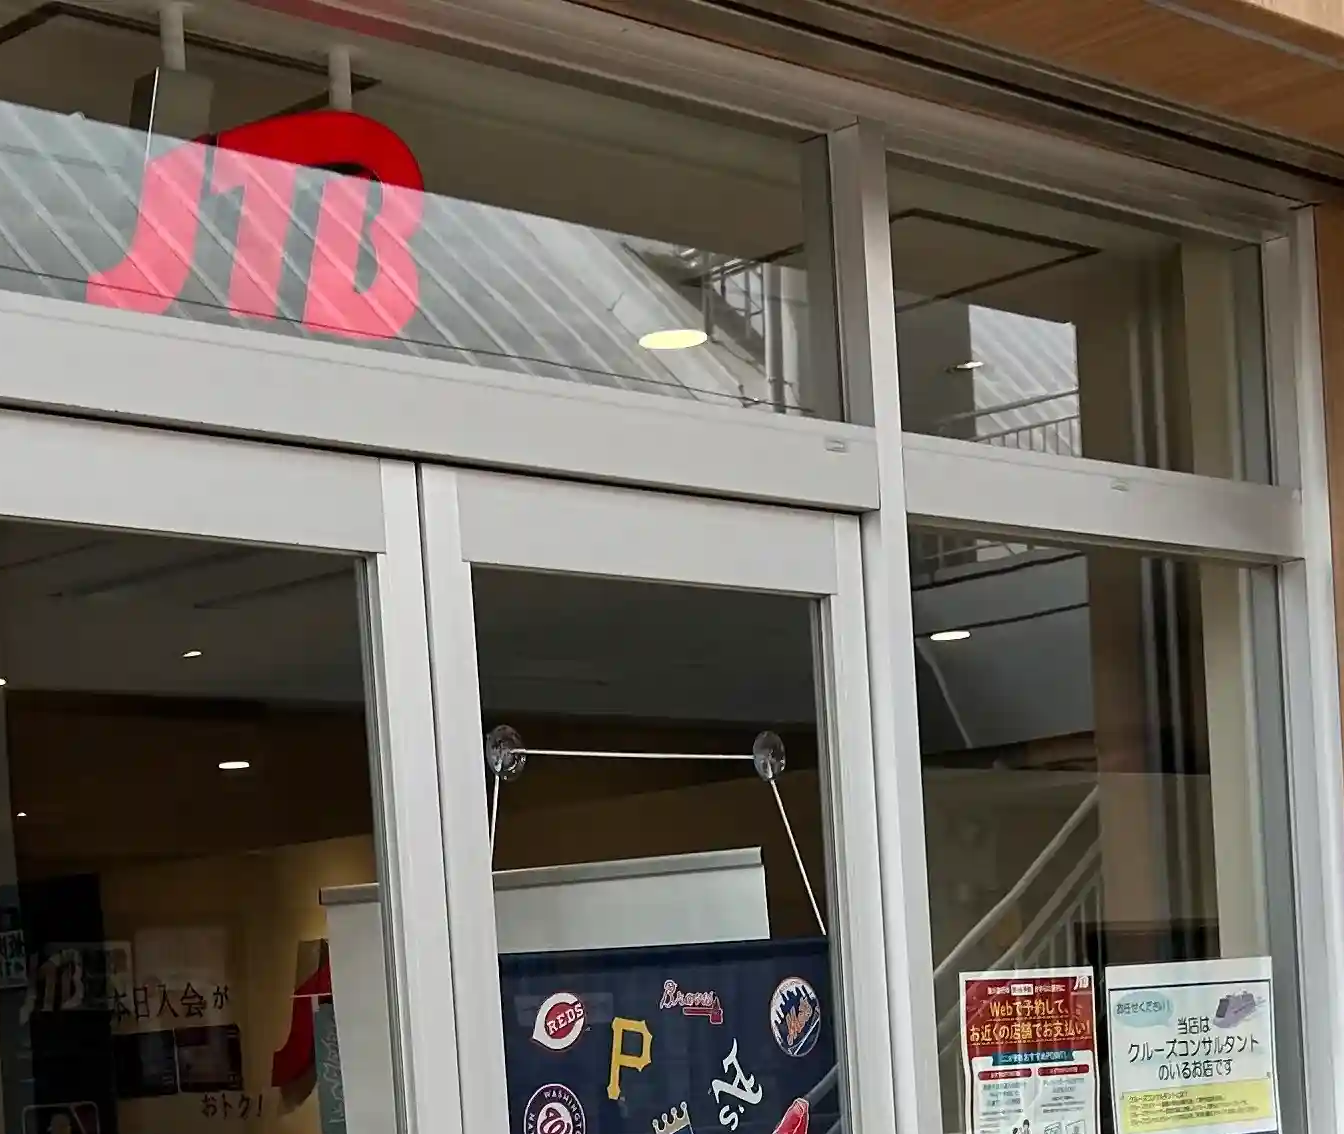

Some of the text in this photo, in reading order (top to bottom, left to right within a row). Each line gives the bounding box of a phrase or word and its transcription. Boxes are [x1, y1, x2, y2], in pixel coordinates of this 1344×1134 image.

[86, 111, 404, 340] JTB
[546, 1002, 584, 1036] REDS
[1178, 1016, 1211, 1035] 当店は
[607, 1017, 653, 1100] P
[1128, 1035, 1259, 1063] クルーズコンサルタント
[1158, 1058, 1233, 1081] のいるお店です
